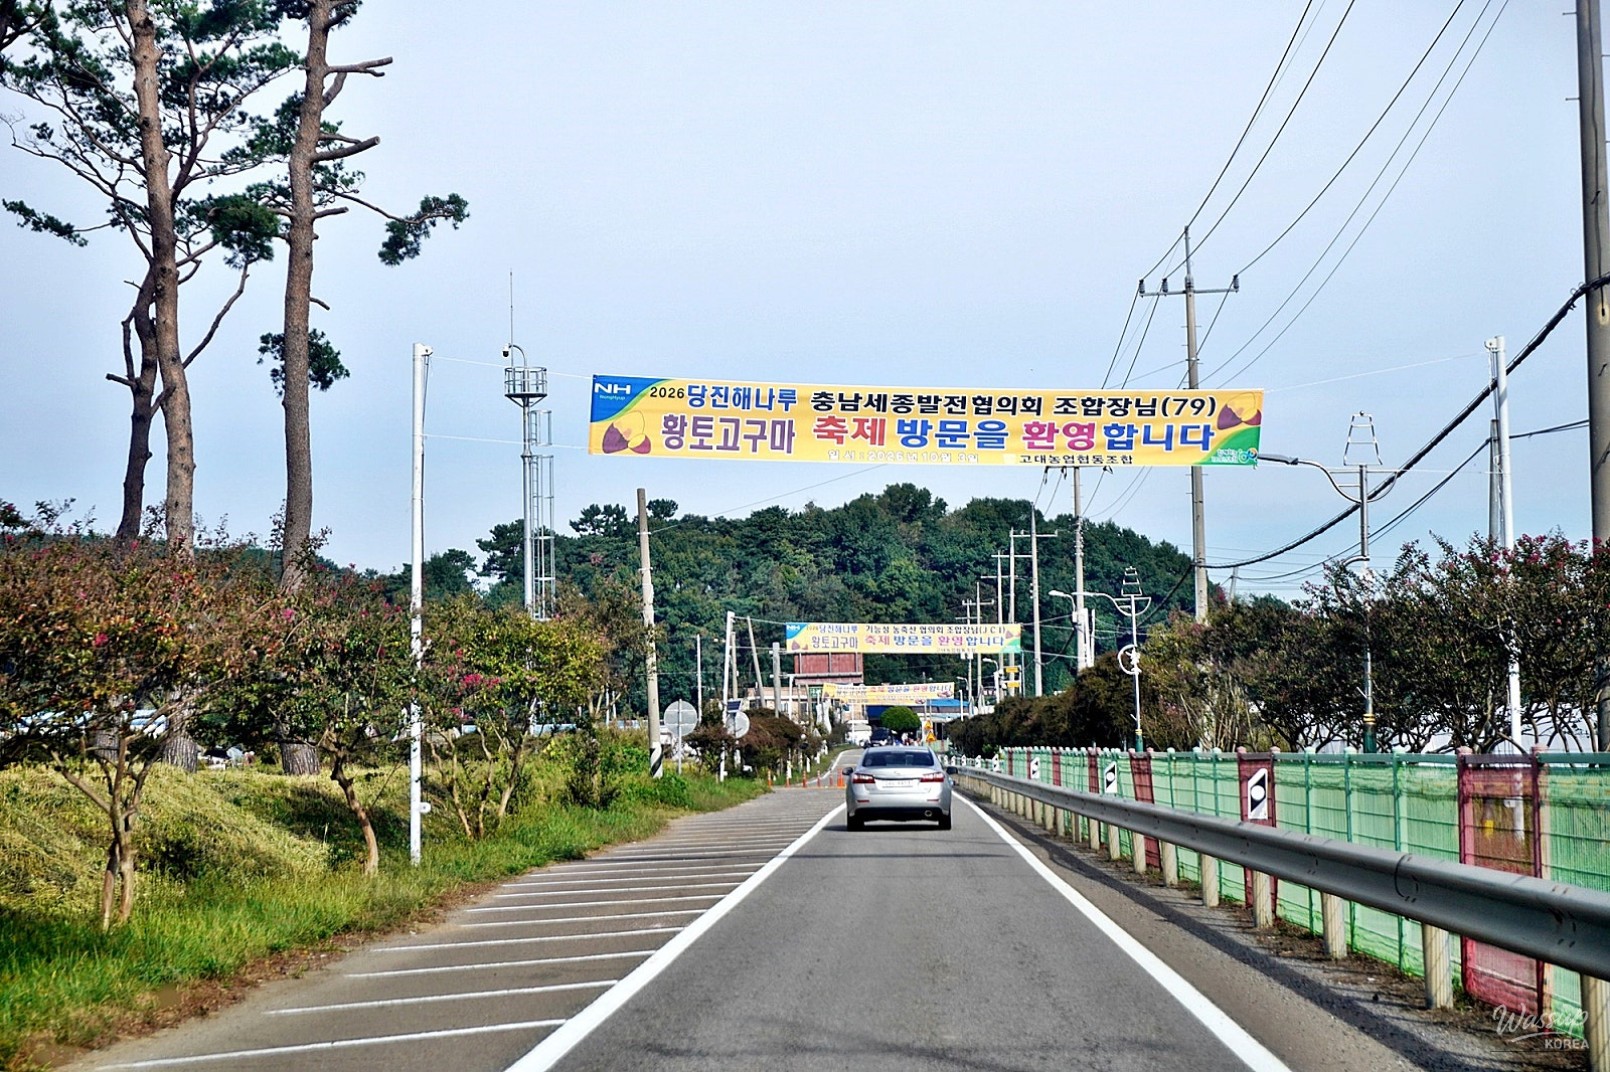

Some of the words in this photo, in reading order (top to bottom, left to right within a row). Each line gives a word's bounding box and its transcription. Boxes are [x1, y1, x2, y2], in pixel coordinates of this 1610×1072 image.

[594, 382, 631, 395] NH
[650, 386, 685, 399] 2026
[686, 384, 797, 411] 당진해나루
[810, 390, 1042, 416] 충남세종발전협의회
[1053, 395, 1217, 417] 조합장님(79)
[661, 413, 795, 454] 황토고구마
[812, 416, 887, 446] 축제
[896, 417, 1009, 450] 방문을
[1020, 454, 1133, 465] 고대농업협동조합
